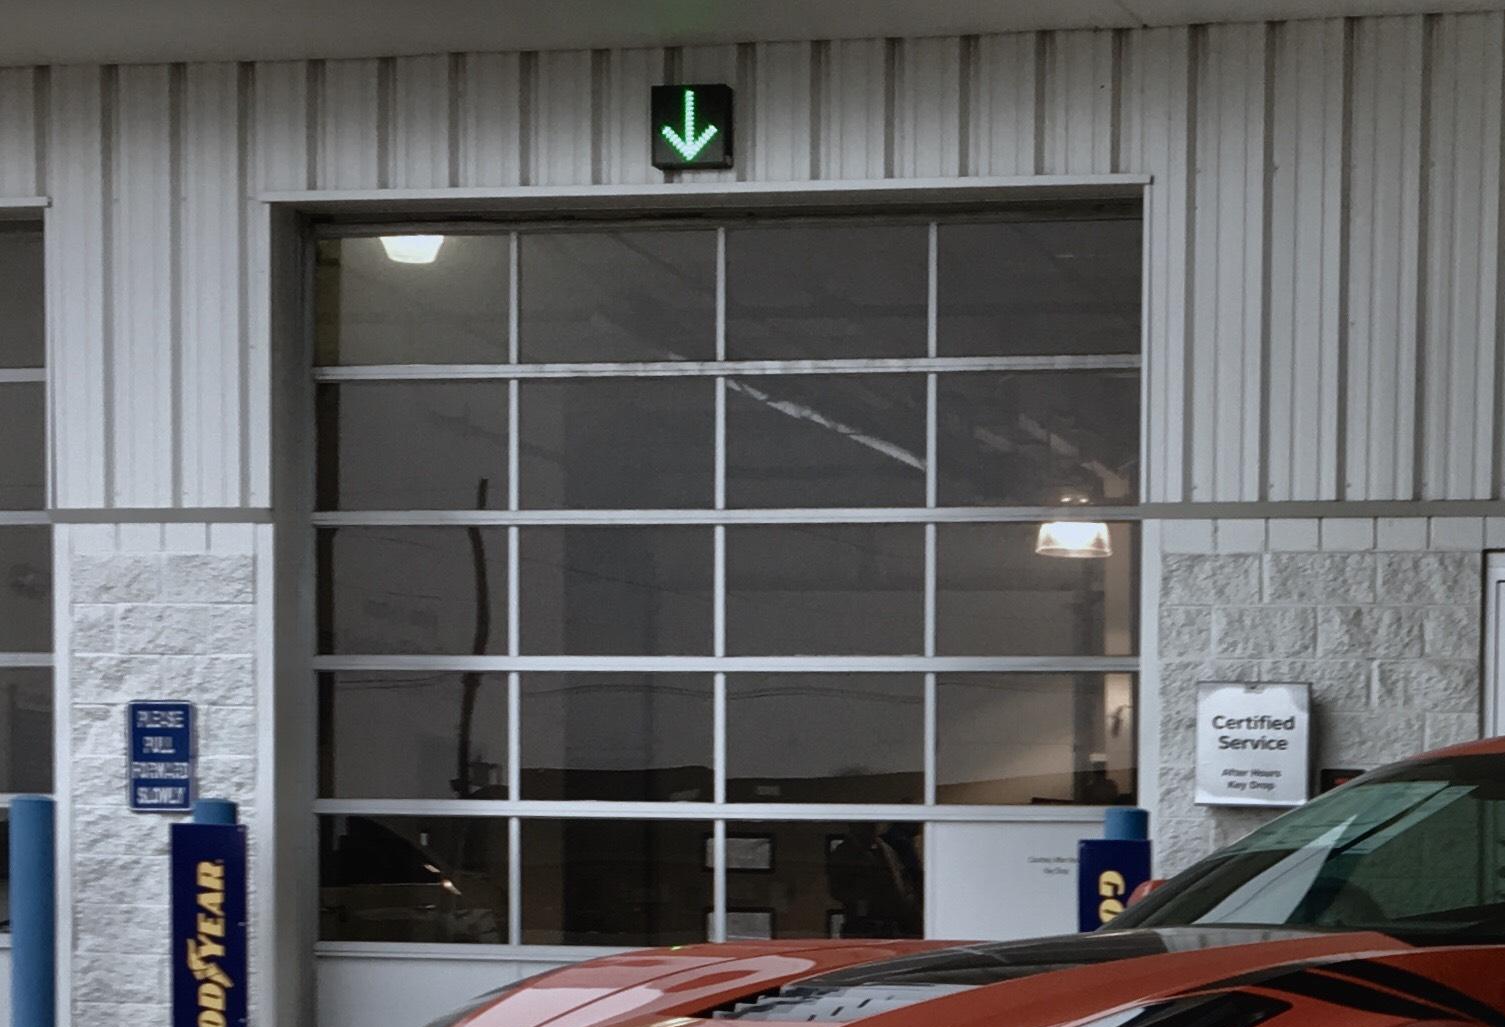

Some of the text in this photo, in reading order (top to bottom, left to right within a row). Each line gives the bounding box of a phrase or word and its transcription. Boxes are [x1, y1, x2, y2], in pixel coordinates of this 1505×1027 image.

[136, 710, 184, 728] PLEASE
[1212, 715, 1296, 731] Certified
[142, 736, 176, 754] PULL
[1218, 735, 1288, 751] Service
[131, 761, 189, 779] FORWARD
[1227, 781, 1275, 791] Key Drop
[136, 787, 186, 804] SLOWLY
